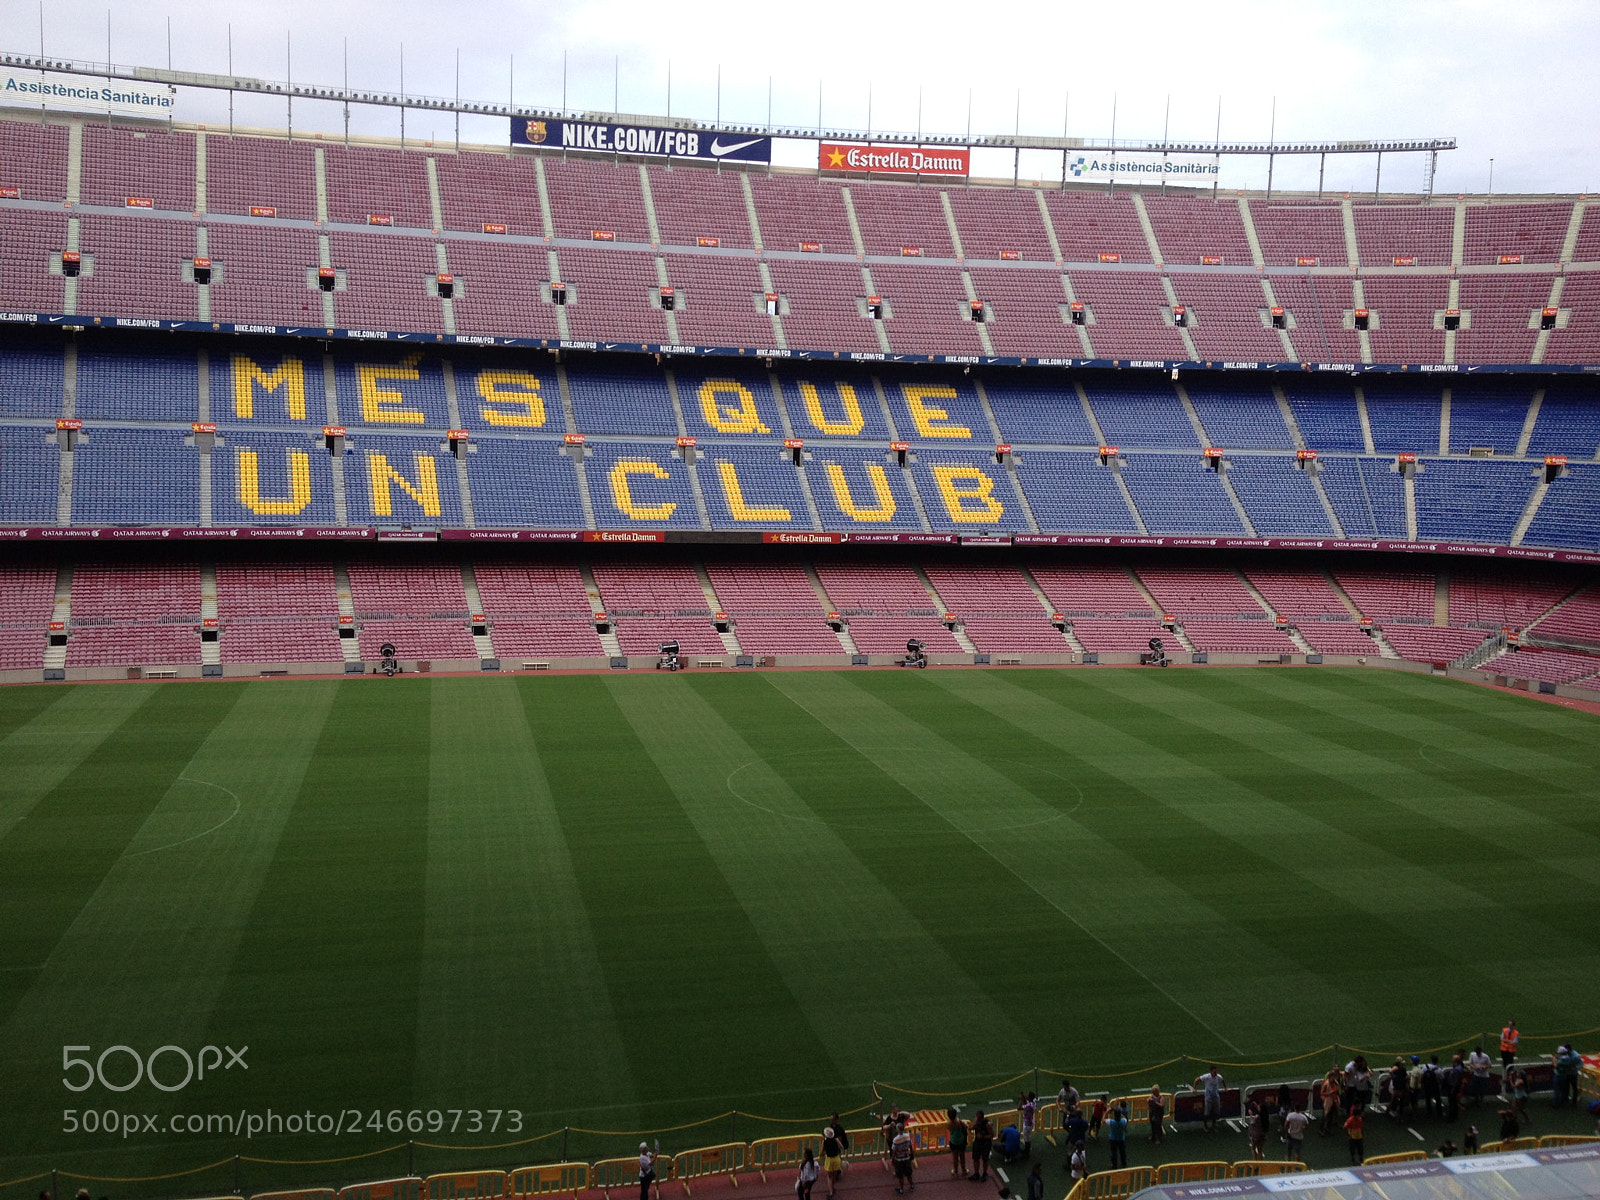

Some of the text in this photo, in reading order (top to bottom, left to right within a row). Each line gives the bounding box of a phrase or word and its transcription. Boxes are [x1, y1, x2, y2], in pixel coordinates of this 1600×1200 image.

[6, 78, 170, 107] Assistència Sanitària
[562, 123, 699, 156] NIKE.COM/FCB
[847, 148, 963, 171] Estrella Damm
[1090, 160, 1219, 174] Assistència Sanitària
[237, 450, 1004, 523] UN CLUB
[602, 533, 656, 542] Estrella Damm
[809, 535, 831, 543] Damm
